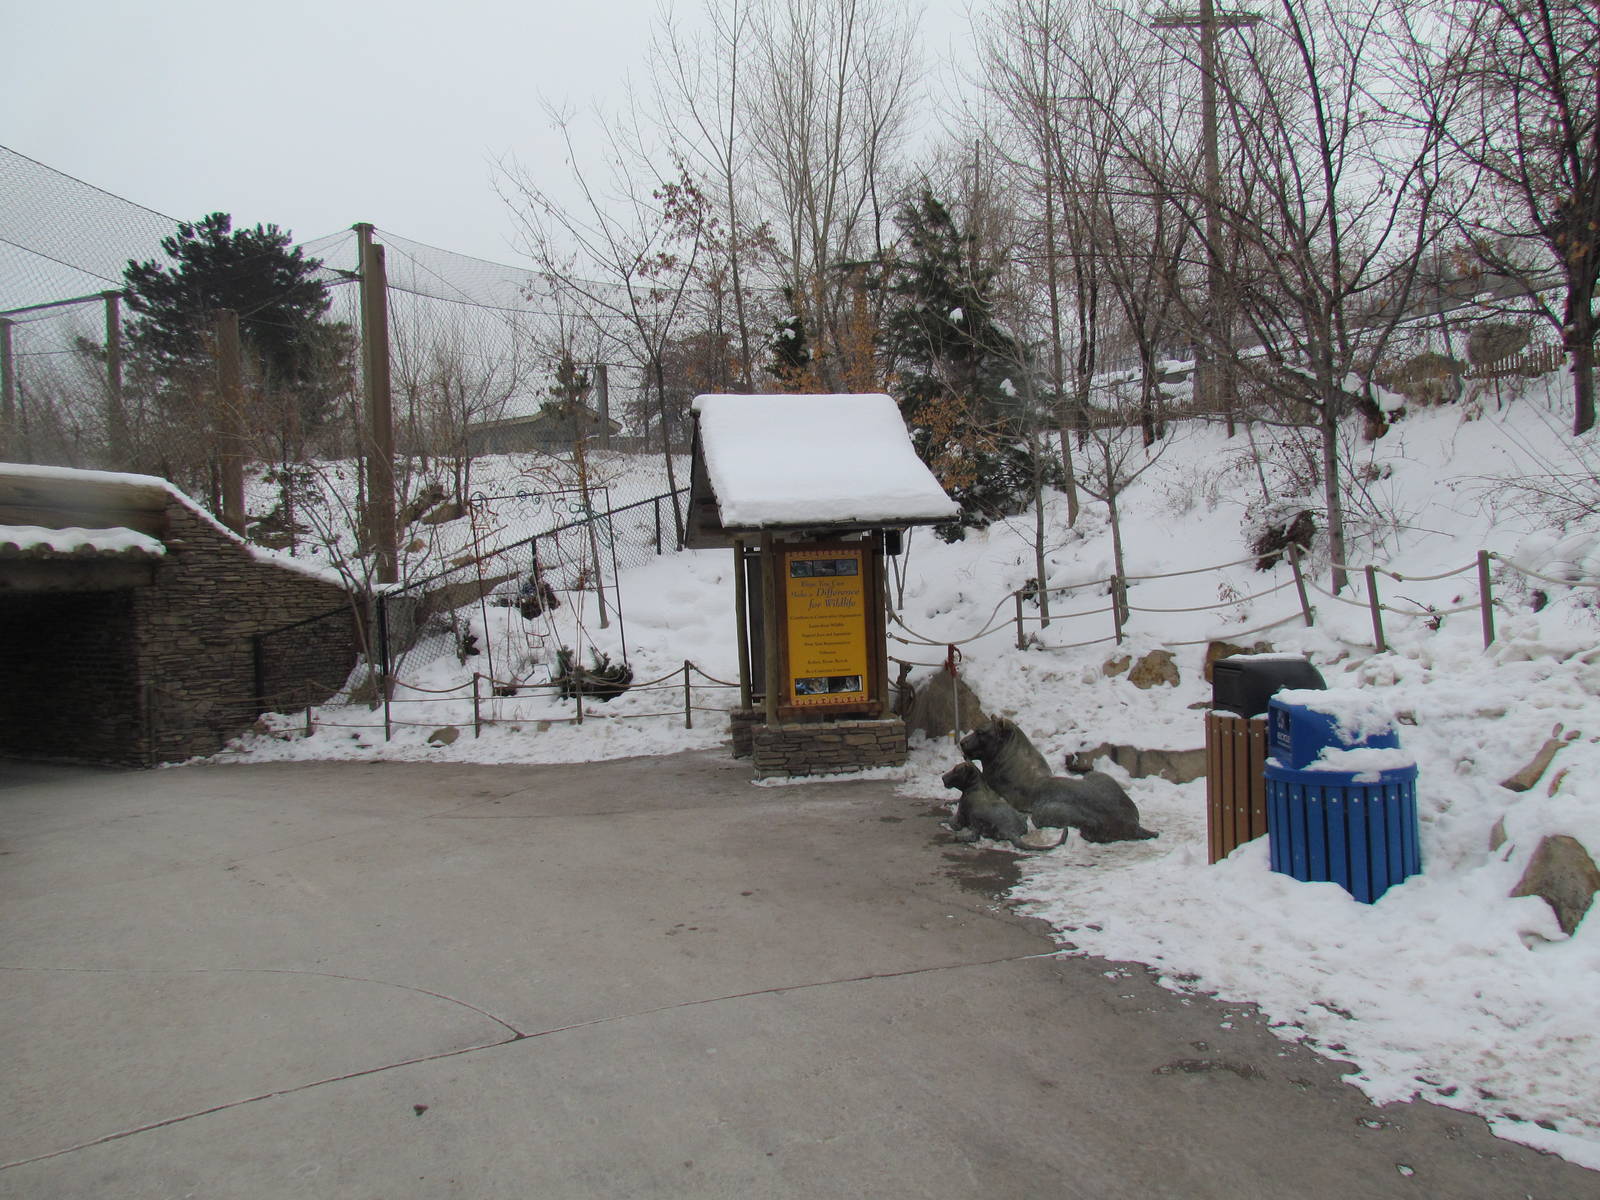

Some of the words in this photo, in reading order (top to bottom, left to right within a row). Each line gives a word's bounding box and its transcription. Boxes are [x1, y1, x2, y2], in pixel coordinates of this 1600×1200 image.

[816, 588, 860, 598] Difference
[808, 599, 822, 611] for
[825, 597, 856, 608] Wildlife
